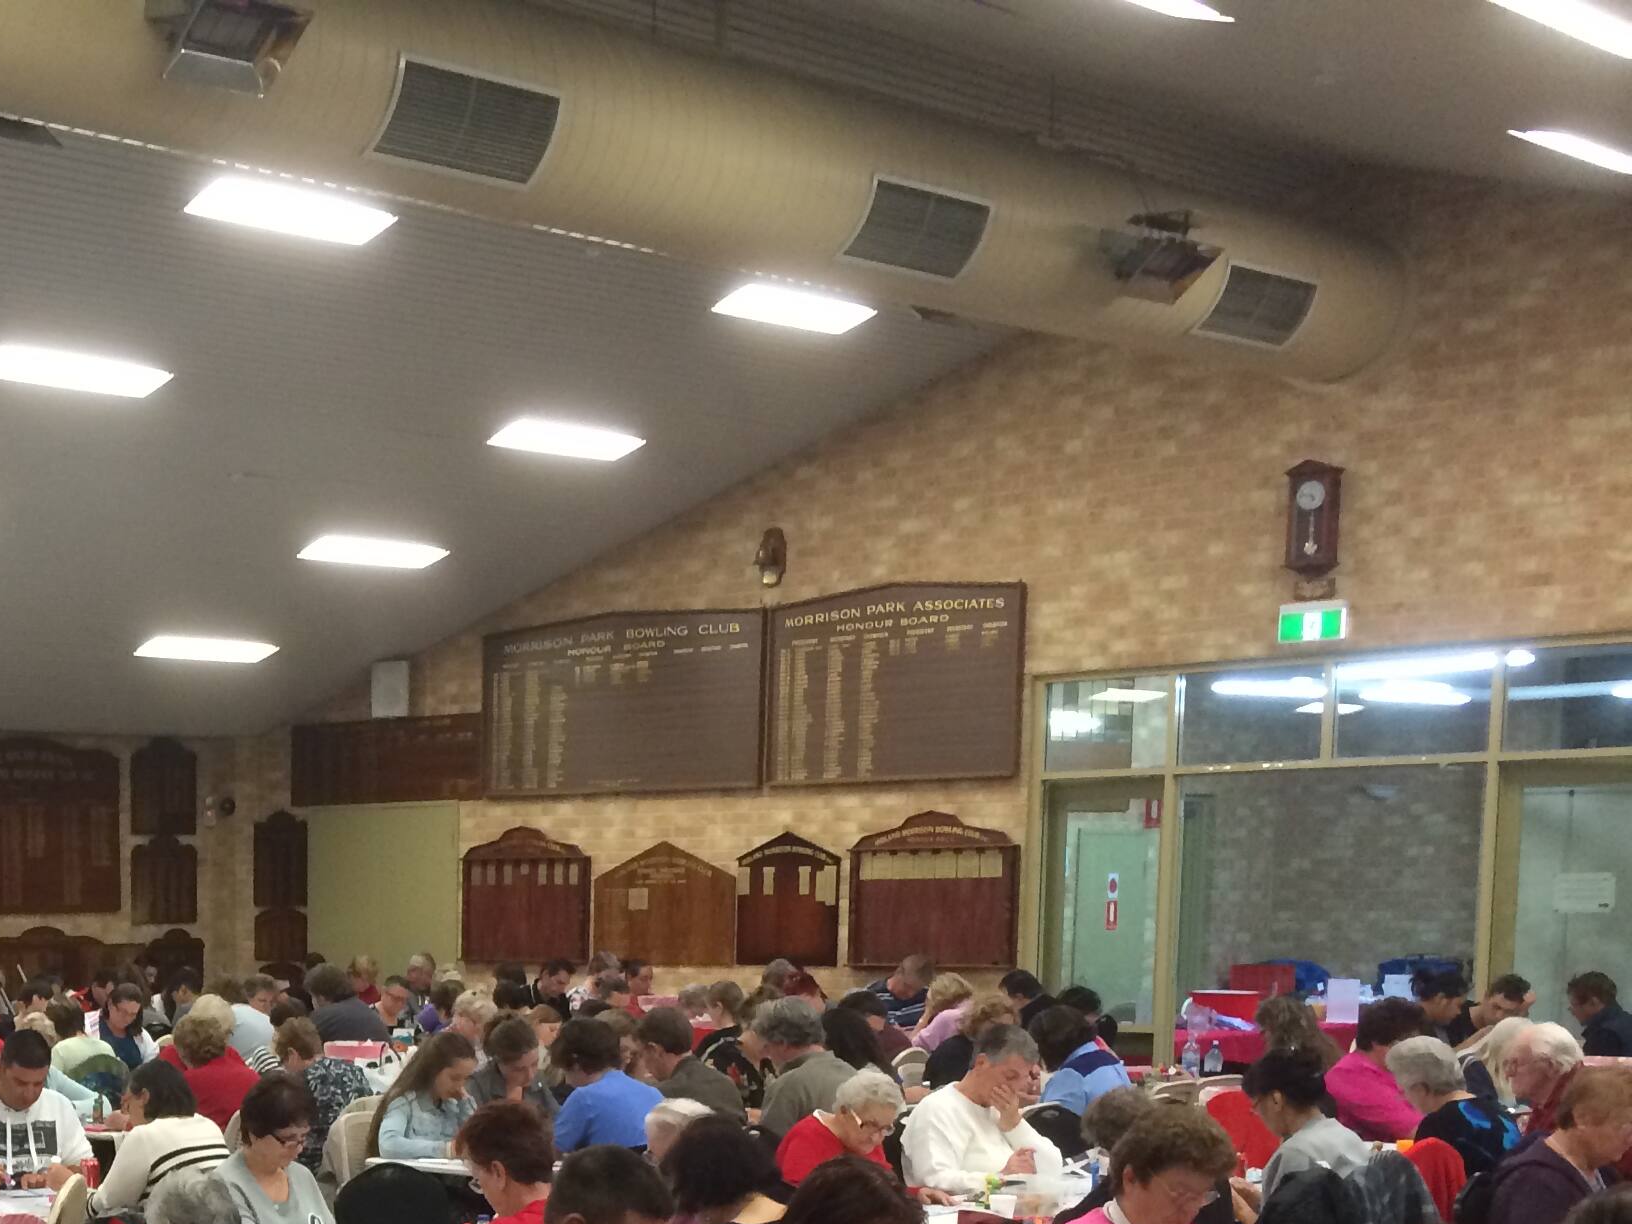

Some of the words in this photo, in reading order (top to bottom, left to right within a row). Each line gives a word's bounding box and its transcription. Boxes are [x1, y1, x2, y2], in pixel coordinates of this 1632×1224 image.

[784, 607, 861, 629] MORRISON
[866, 601, 905, 614] PARK
[912, 597, 1006, 611] ASSOCIATES
[836, 619, 893, 632] HONOUR
[900, 614, 950, 626] BOARD
[580, 630, 614, 644] PARK
[626, 625, 688, 639] BOWLING
[698, 622, 741, 635] CLUB
[567, 644, 612, 657] HONOUR
[623, 640, 666, 651] BOARD
